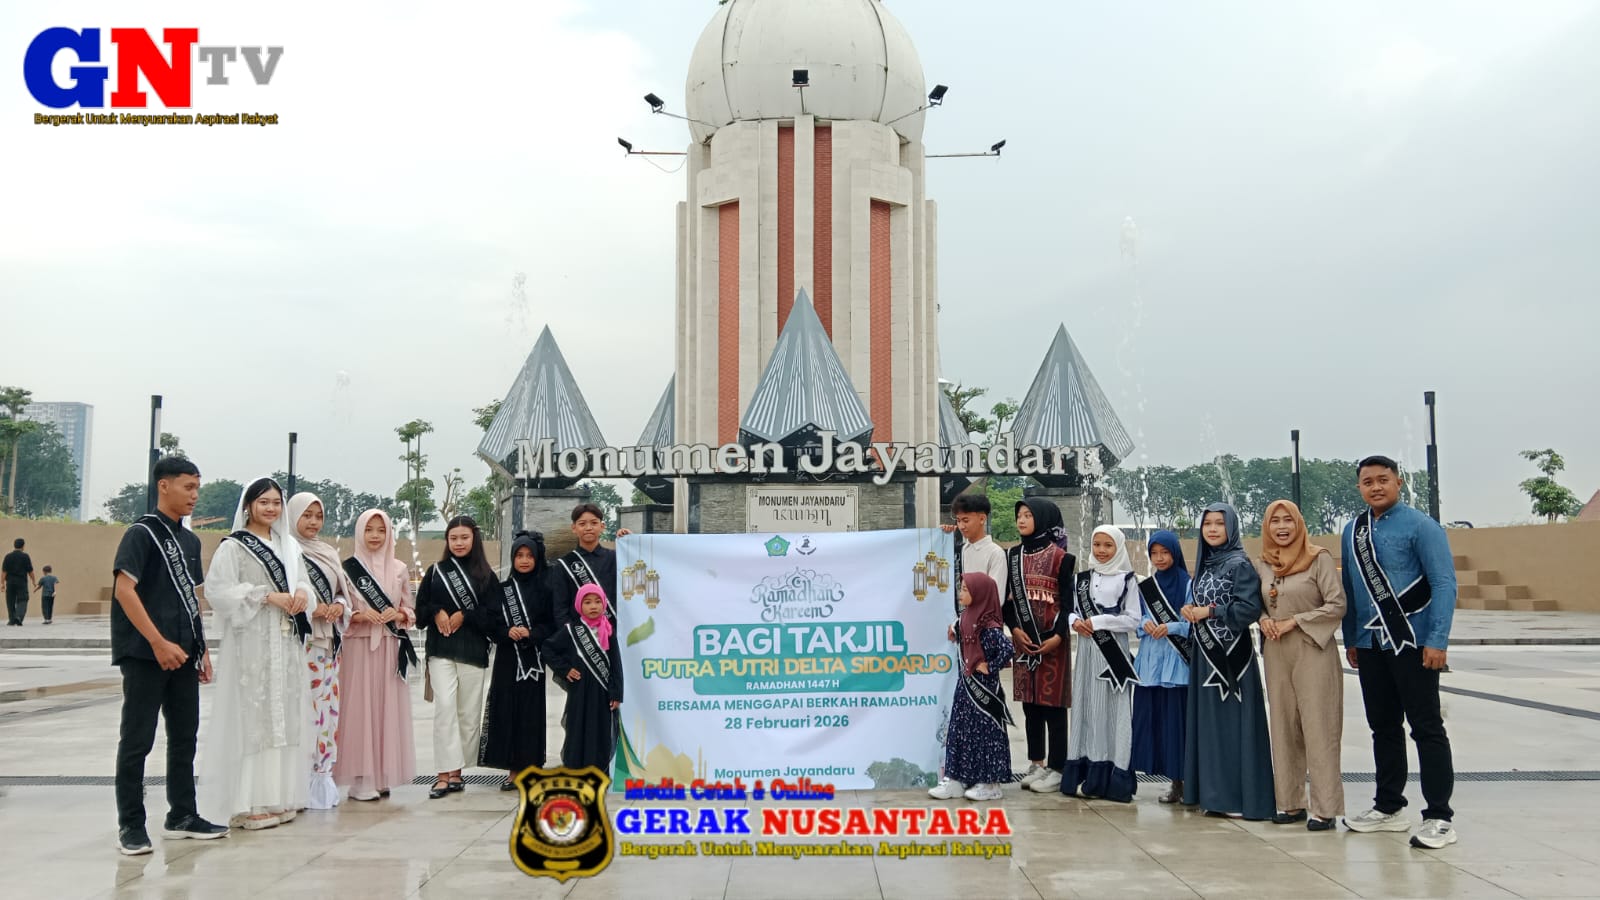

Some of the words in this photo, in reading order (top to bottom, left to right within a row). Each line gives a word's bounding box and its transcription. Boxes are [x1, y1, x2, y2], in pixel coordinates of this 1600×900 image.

[514, 438, 788, 479] Monumen
[799, 430, 1103, 485] Jayandaru
[758, 495, 798, 507] MONUMEN
[800, 495, 846, 507] JAYANDARU
[750, 574, 845, 607] Ramadhan
[760, 603, 833, 624] Kareem
[697, 627, 781, 656] BAGI
[788, 625, 904, 654] TAKJIL
[643, 659, 716, 678] PUTRA
[719, 658, 779, 677] PUTRI
[784, 656, 846, 675] DELTA
[851, 654, 952, 674] SIDOARJO
[746, 680, 806, 691] RAMADHAN
[807, 679, 830, 689] 1447
[831, 679, 840, 689] H
[658, 700, 721, 712] BERSAMA
[724, 698, 804, 711] MENGGAPAI
[806, 697, 858, 709] BERKAH
[860, 695, 938, 708] RAMADHAN
[724, 717, 742, 730] 28
[746, 715, 810, 729] Februari
[814, 715, 849, 728] 2026
[714, 767, 777, 779] Monumen
[782, 765, 855, 779] Jayandaru
